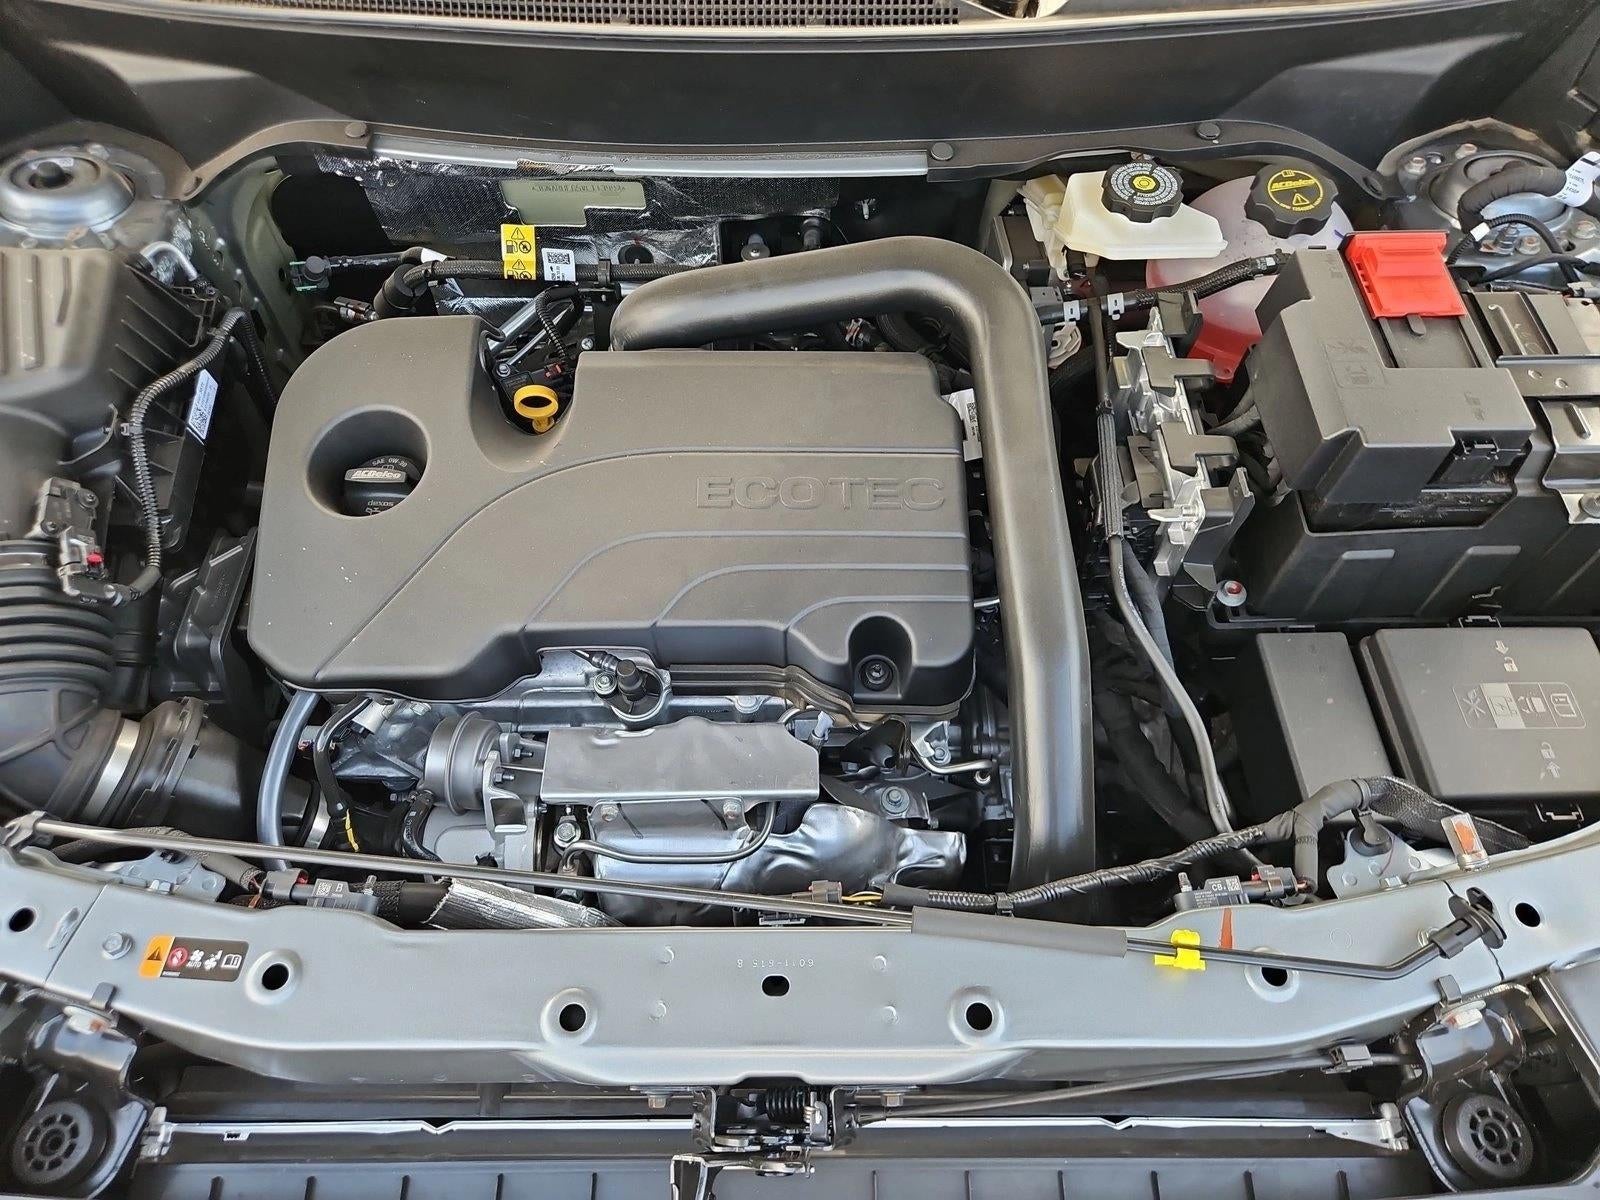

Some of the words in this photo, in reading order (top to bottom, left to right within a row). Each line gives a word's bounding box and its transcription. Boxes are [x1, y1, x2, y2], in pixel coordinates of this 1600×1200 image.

[371, 458, 385, 466] SAE
[388, 457, 408, 468] 0W-20
[350, 470, 402, 479] ACDelco
[696, 476, 946, 512] ECOTEC
[186, 960, 202, 968] AUTO
